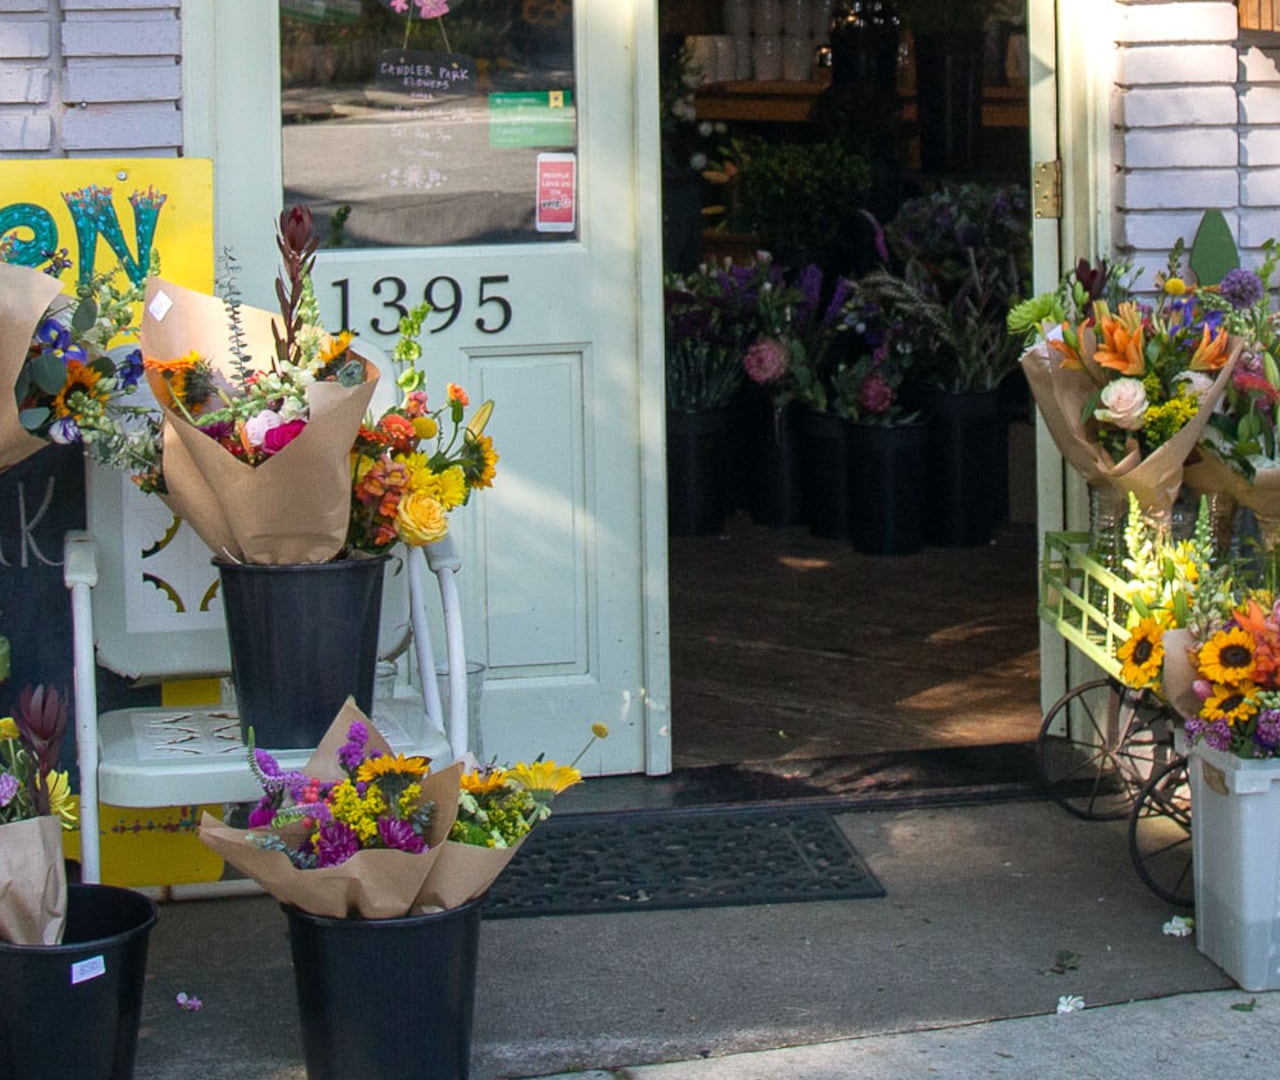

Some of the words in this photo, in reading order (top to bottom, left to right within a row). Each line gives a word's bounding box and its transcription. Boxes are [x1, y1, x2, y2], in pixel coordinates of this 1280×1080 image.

[380, 62, 433, 77] CANDLER
[439, 66, 470, 81] PARK
[330, 274, 512, 337] 1395
